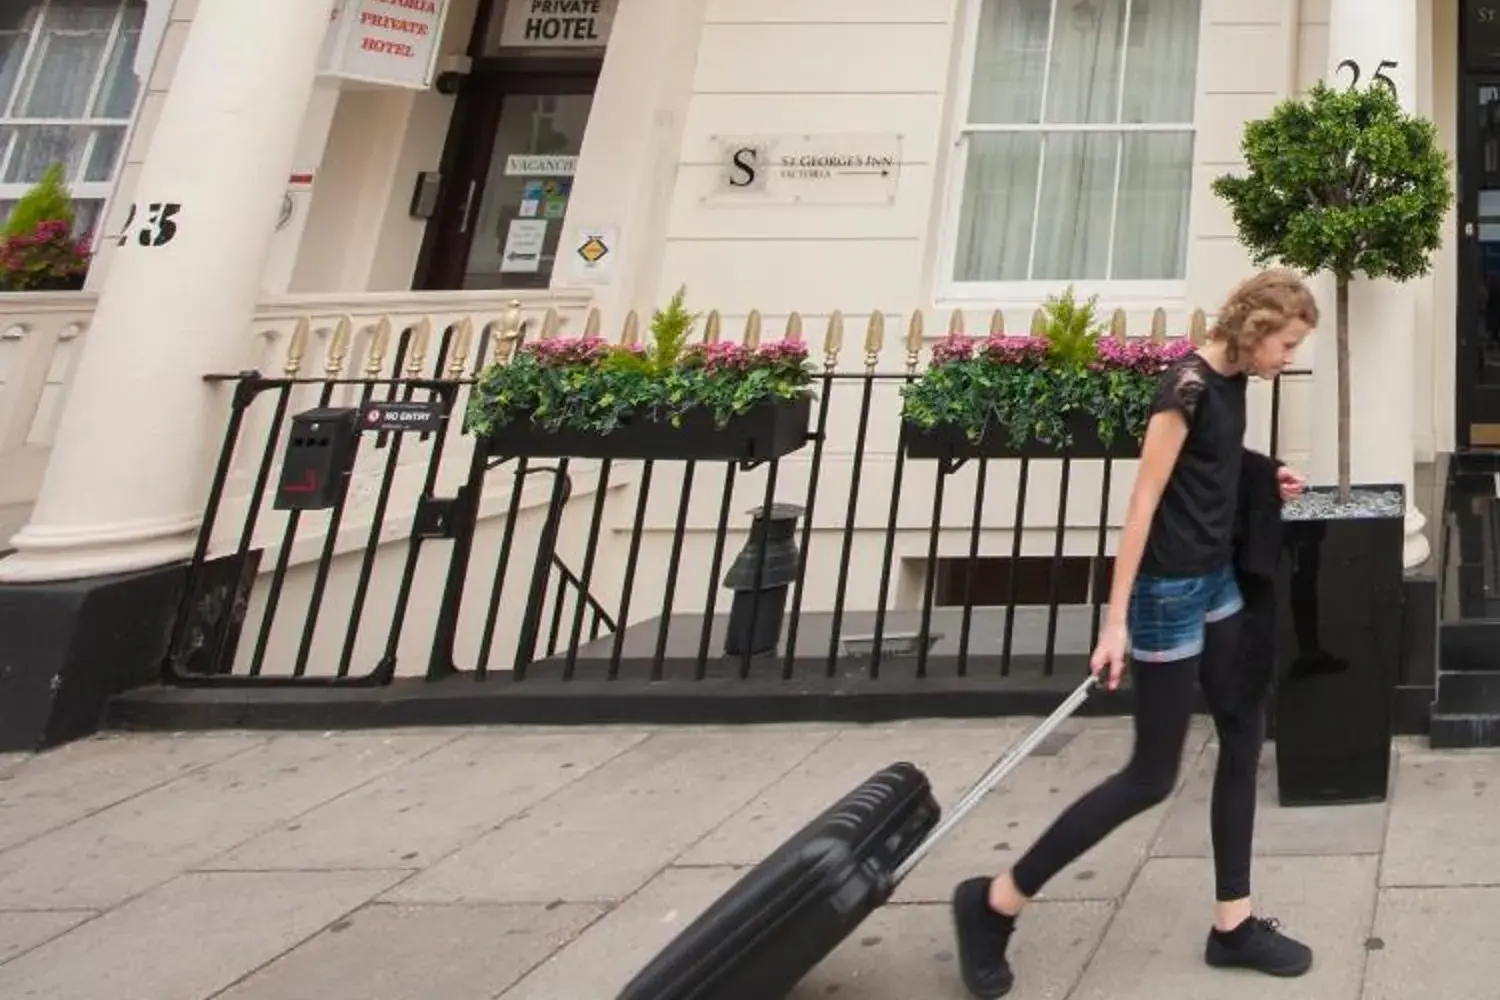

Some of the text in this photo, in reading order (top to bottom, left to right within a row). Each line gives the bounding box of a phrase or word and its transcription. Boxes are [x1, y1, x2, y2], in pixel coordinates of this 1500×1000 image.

[531, 0, 601, 14] PRIVATE
[360, 11, 430, 37] PRIVATE
[524, 18, 598, 40] HOTEL
[360, 37, 415, 58] HOTEL
[1335, 59, 1399, 103] 25
[729, 147, 757, 187] S
[780, 168, 831, 179] VICTORIA
[384, 410, 432, 421] NO ENTRY
